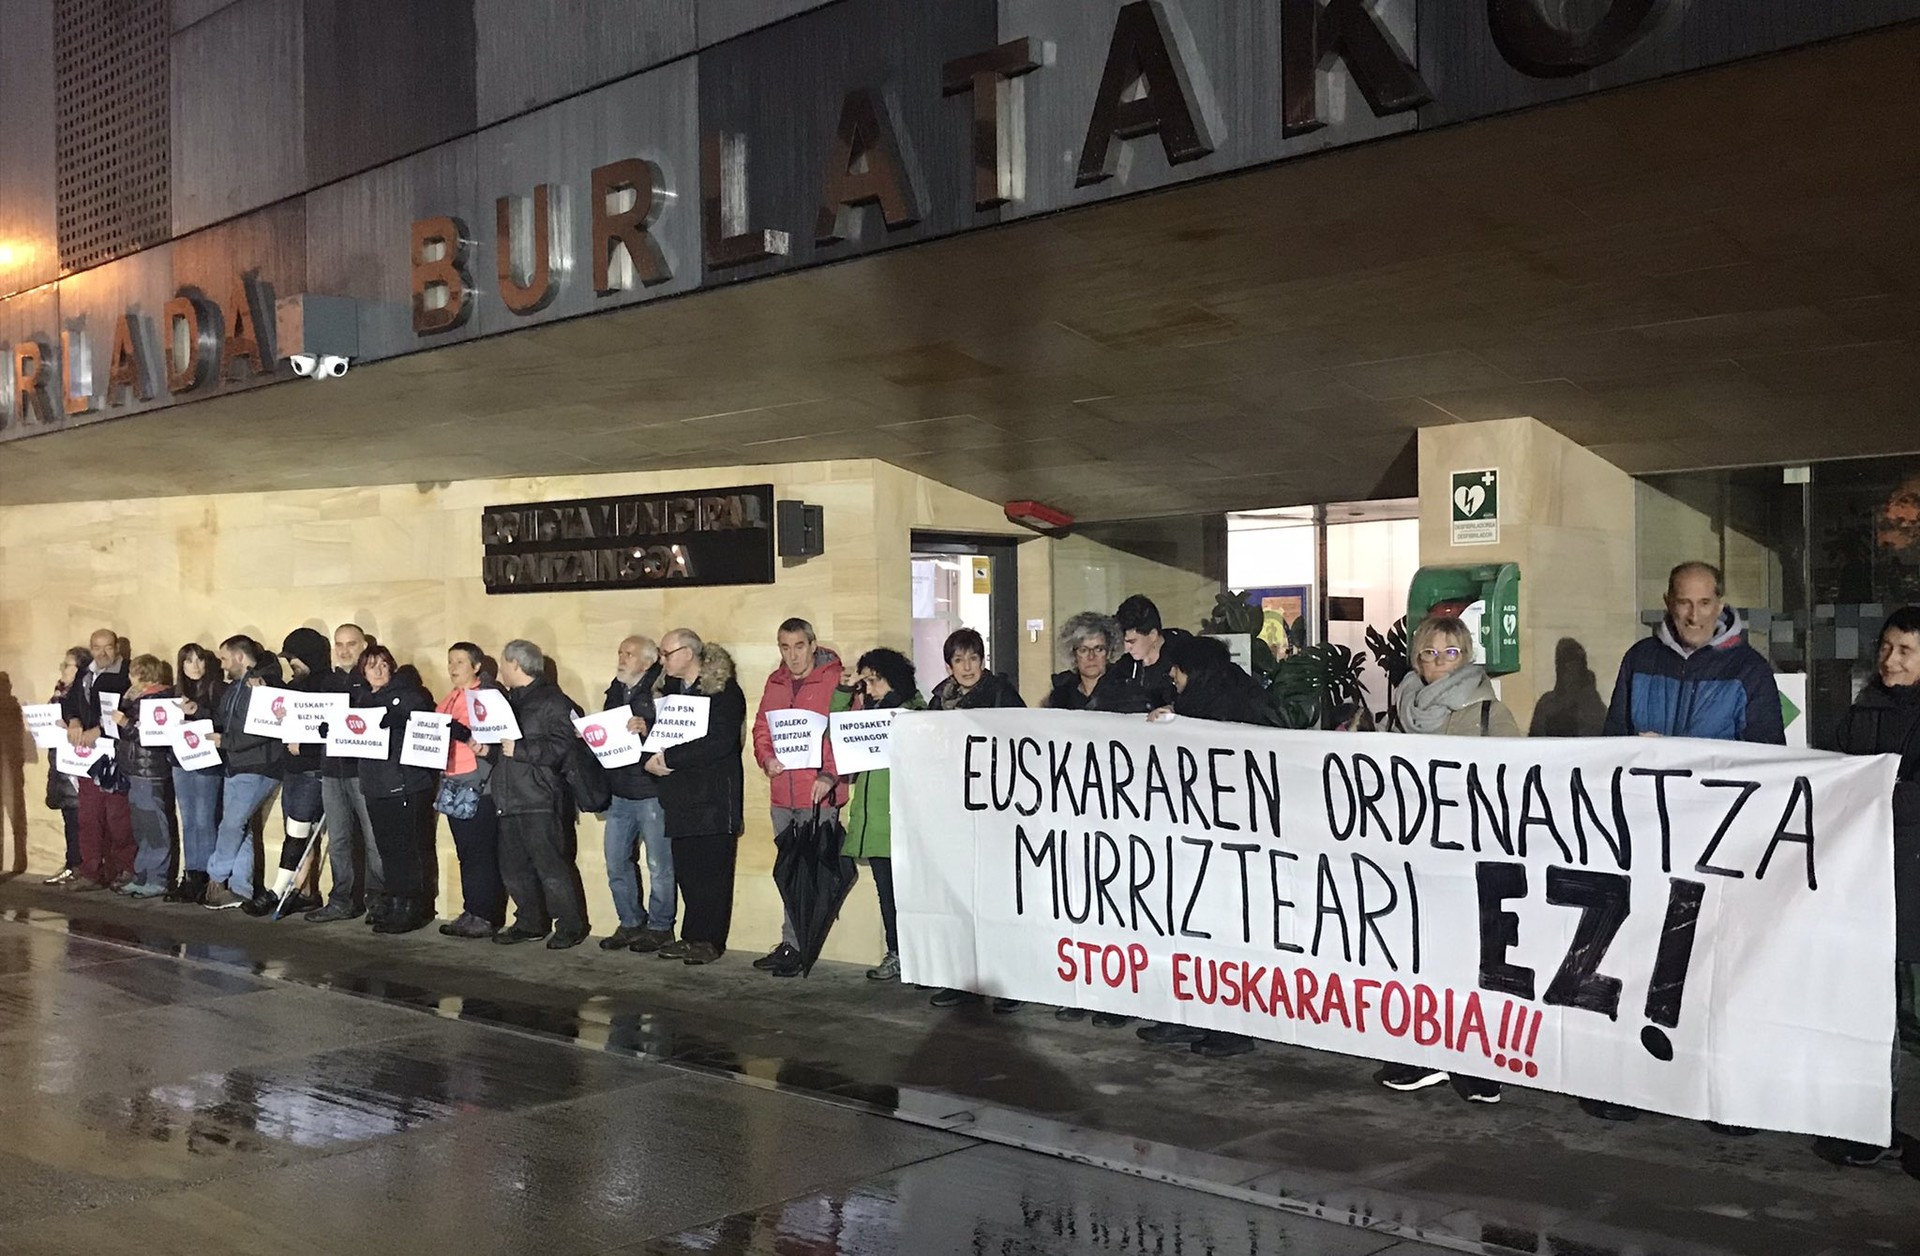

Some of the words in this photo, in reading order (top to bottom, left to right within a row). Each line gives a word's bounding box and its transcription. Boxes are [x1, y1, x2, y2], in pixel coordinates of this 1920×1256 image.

[0, 266, 277, 430] RLADA
[677, 705, 695, 713] PSN
[774, 718, 808, 728] UDALEKO
[650, 730, 685, 739] ETSAIAK
[843, 732, 889, 743] GEHIAGOR
[868, 745, 881, 753] EZ
[963, 734, 1281, 838] EUSKARAREN
[1322, 752, 1818, 891] ORDENANTZA
[1014, 823, 1420, 974] MURRIZTEARI
[1476, 860, 1706, 1062] EZ!
[1056, 936, 1149, 994] STOP
[1171, 952, 1543, 1079] EUSKARAFOBIA!!!
